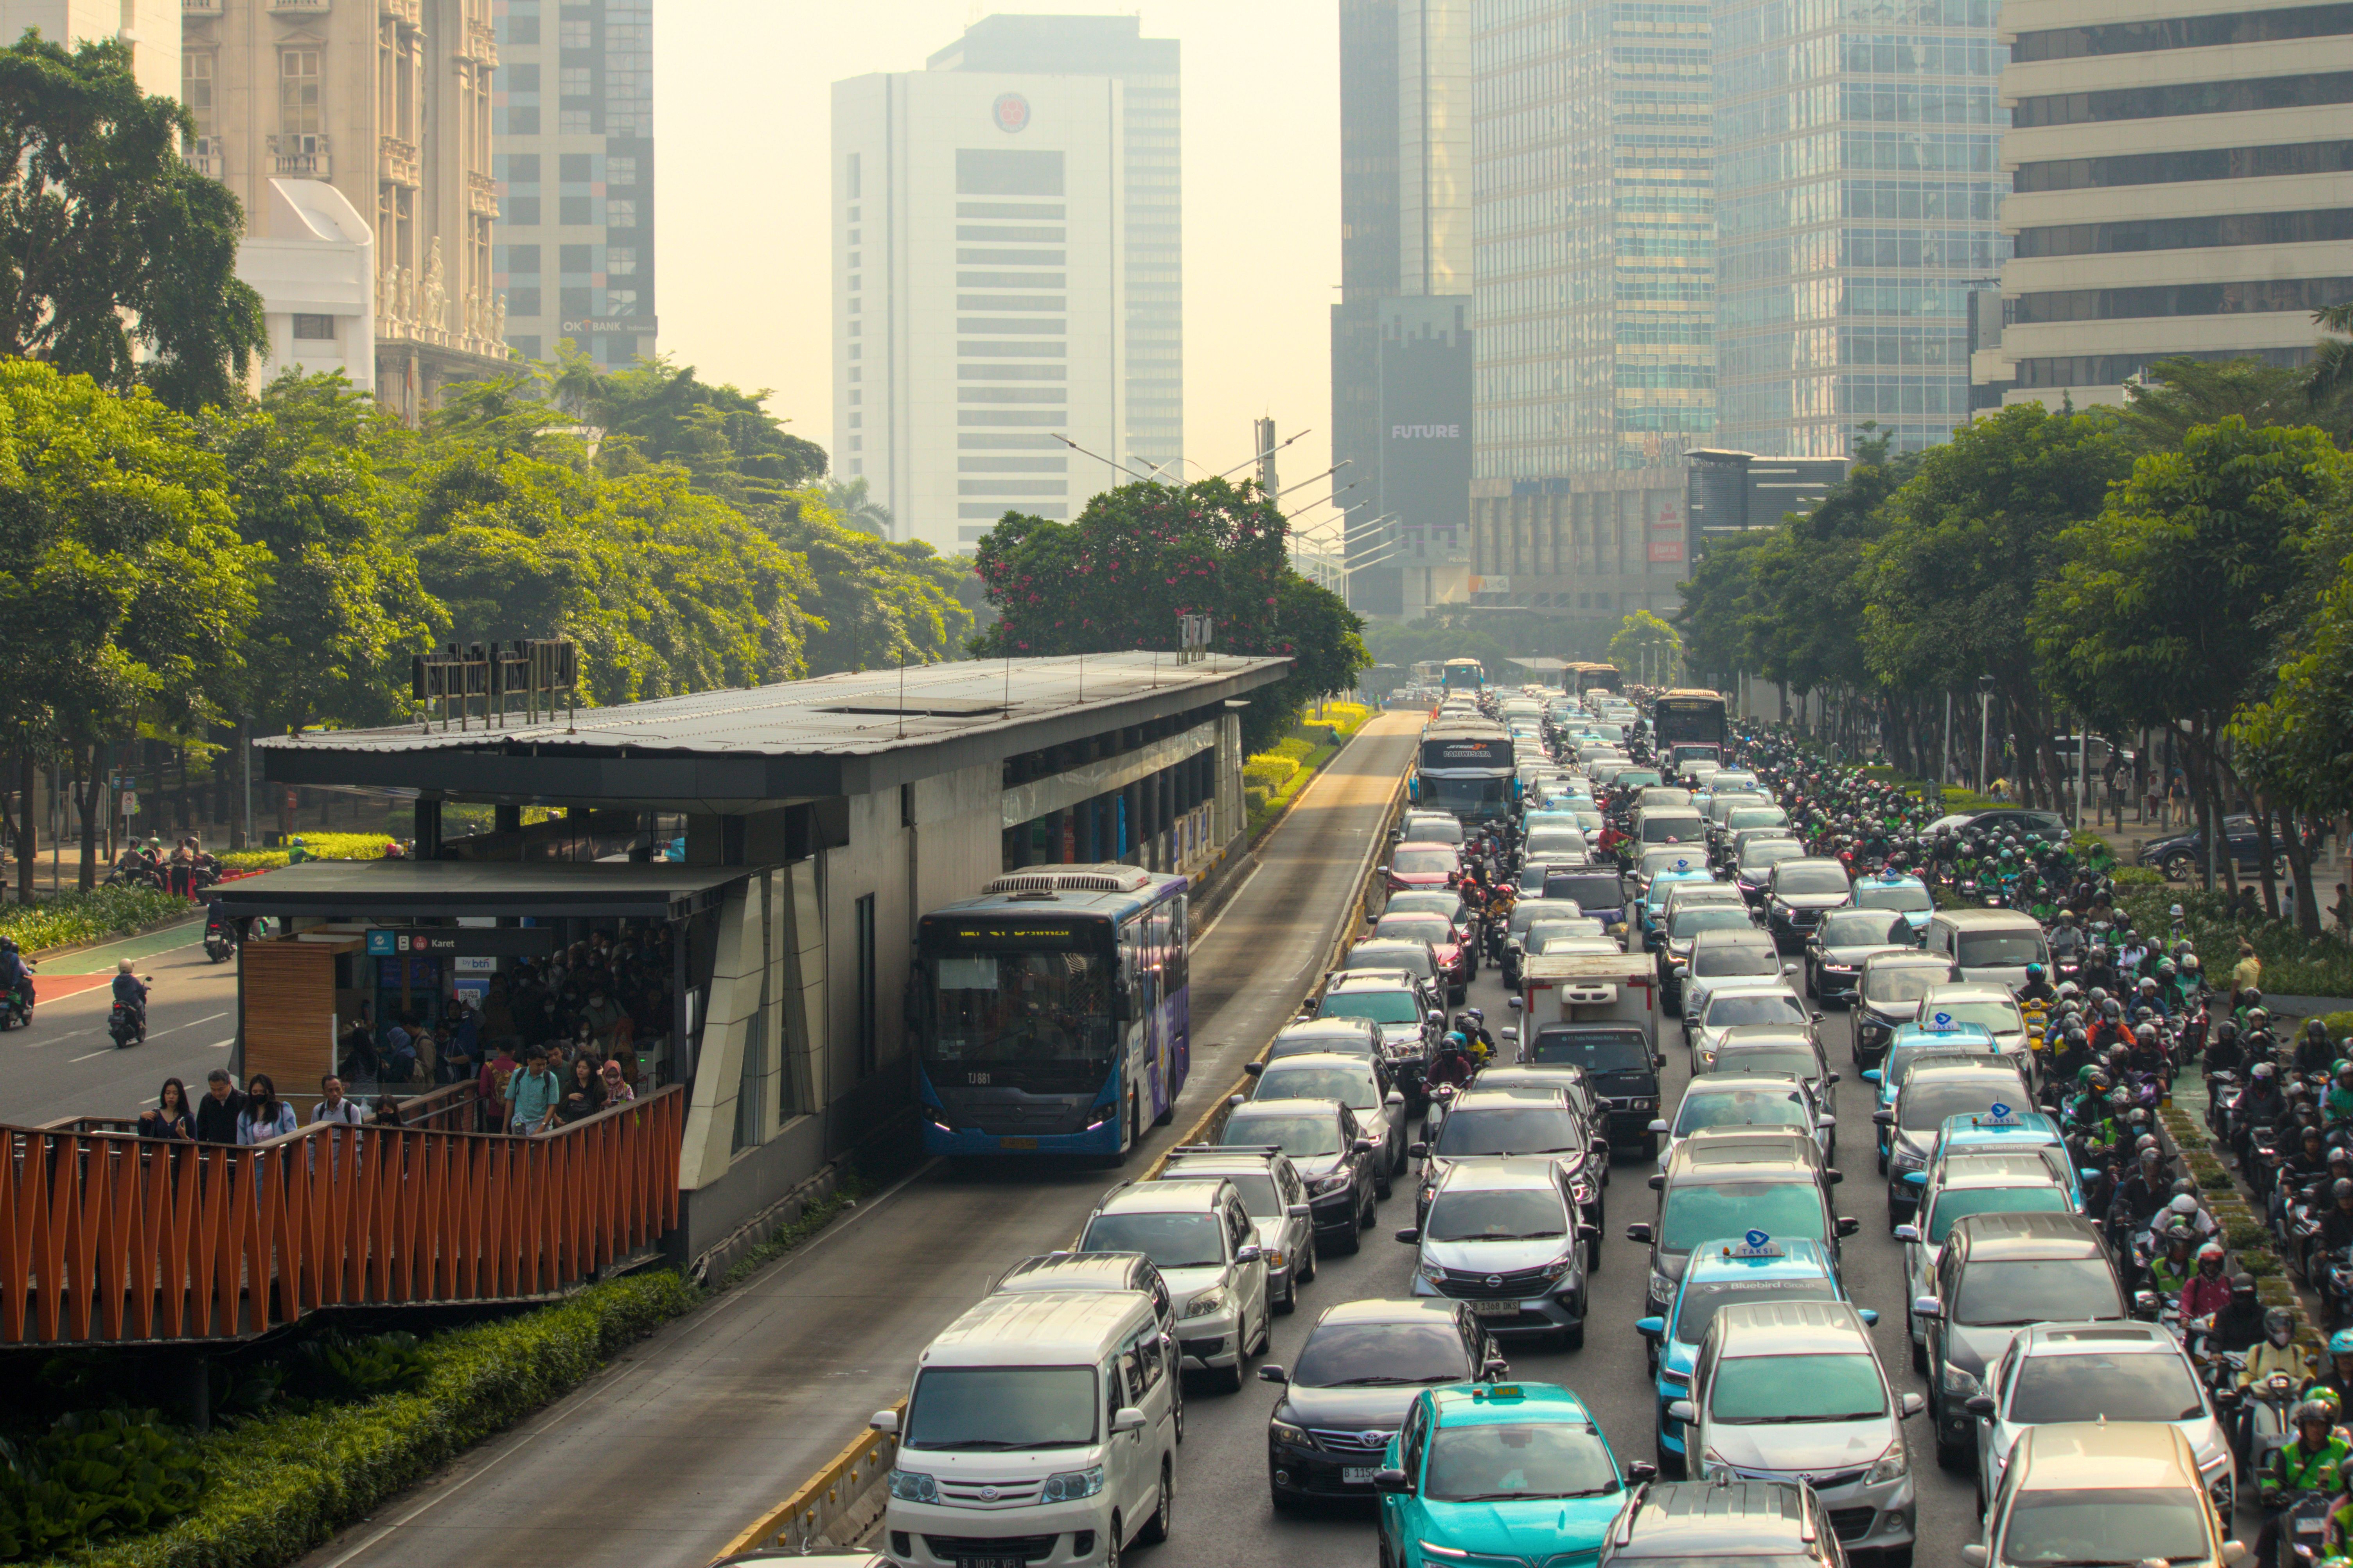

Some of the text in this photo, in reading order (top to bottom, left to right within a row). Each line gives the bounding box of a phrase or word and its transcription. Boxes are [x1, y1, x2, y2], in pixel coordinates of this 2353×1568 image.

[563, 321, 582, 332] OK
[593, 322, 621, 331] BANK
[1392, 424, 1459, 438] FUTURE
[431, 939, 454, 947] Karet
[968, 1073, 990, 1084] TJ 881
[1731, 1281, 1780, 1290] Bluebird
[1473, 1301, 1517, 1311] B 1368 DKS
[1494, 1387, 1518, 1396] TAKSI
[1344, 1468, 1349, 1477] B
[963, 1558, 968, 1568] B
[975, 1559, 996, 1568] 1012
